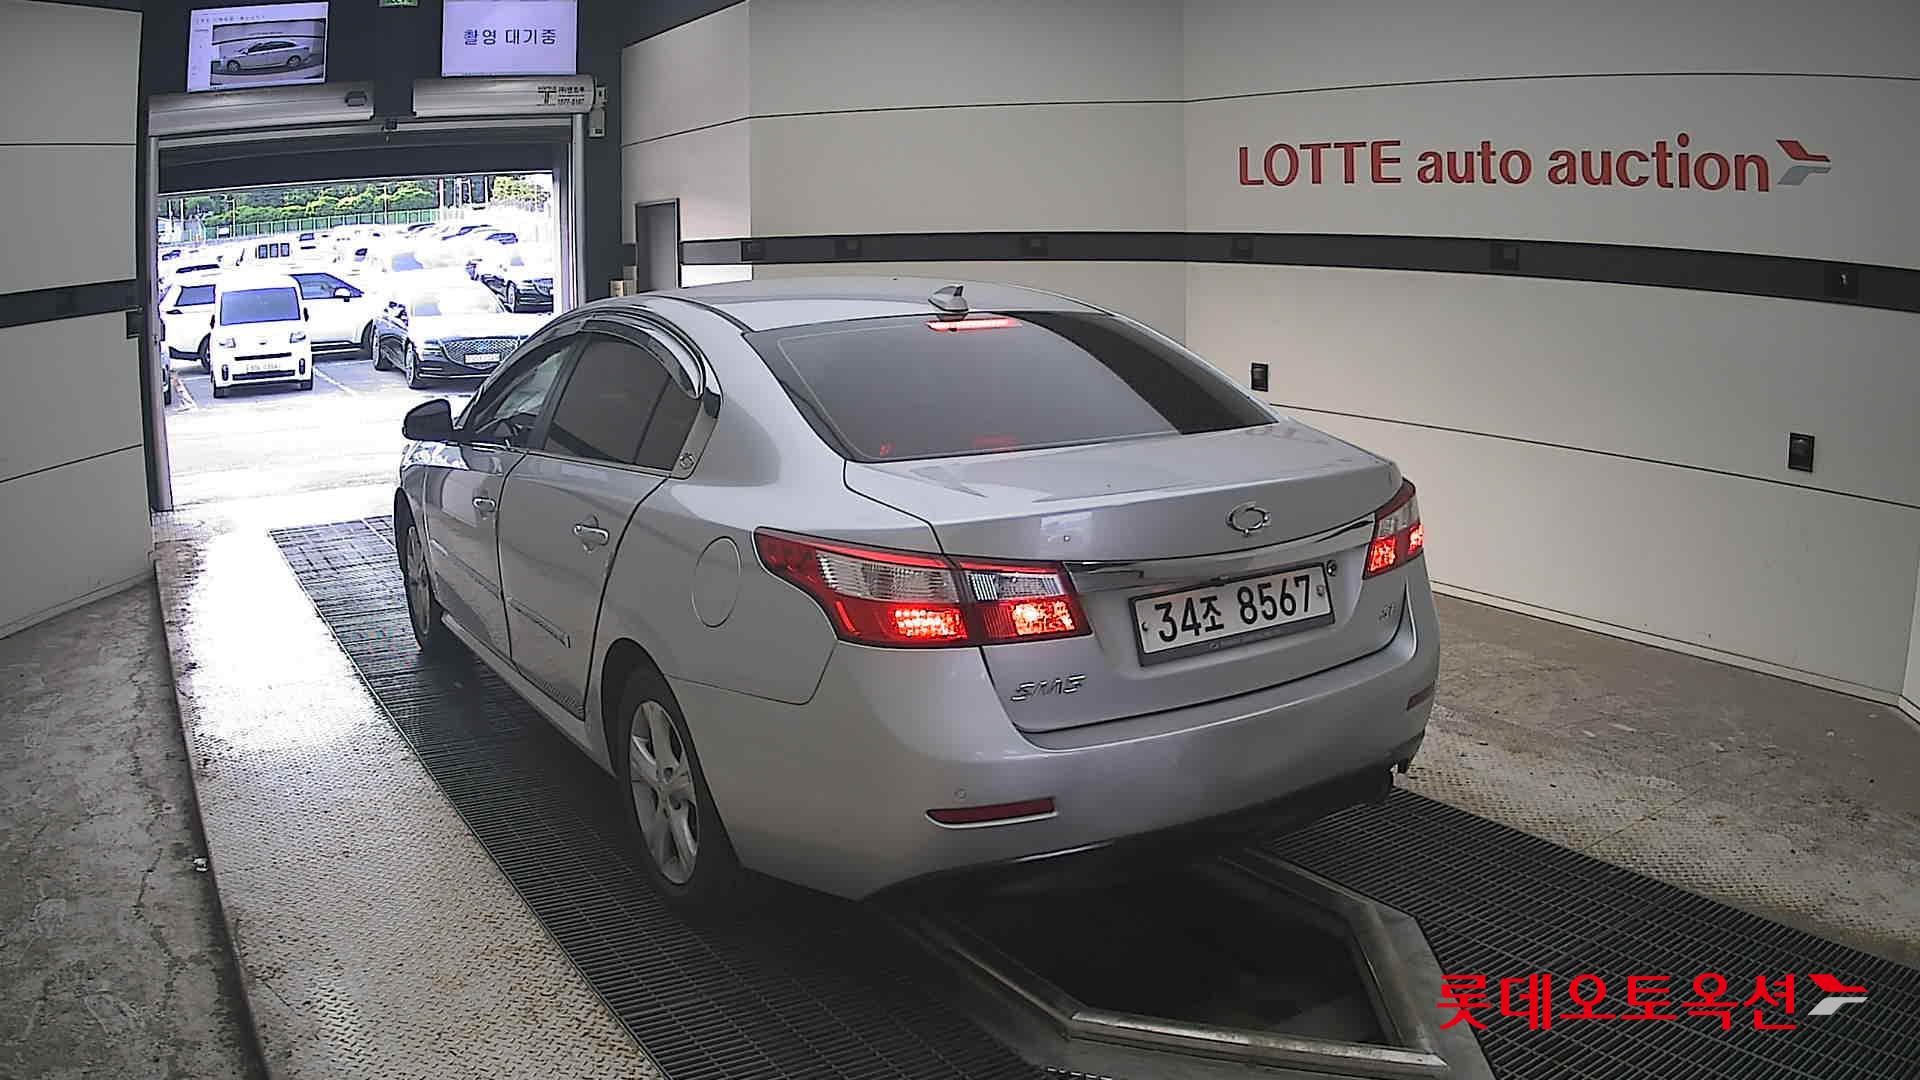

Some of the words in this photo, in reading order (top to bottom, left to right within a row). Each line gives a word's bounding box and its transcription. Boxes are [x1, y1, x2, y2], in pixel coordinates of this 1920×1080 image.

[464, 29, 497, 46] 촬영
[505, 28, 557, 45] 대기중
[1238, 139, 1402, 187] LOTTE
[1416, 140, 1533, 187] auto
[1547, 132, 1770, 193] auction
[1153, 595, 1225, 643] 34조
[1236, 574, 1311, 625] 8567
